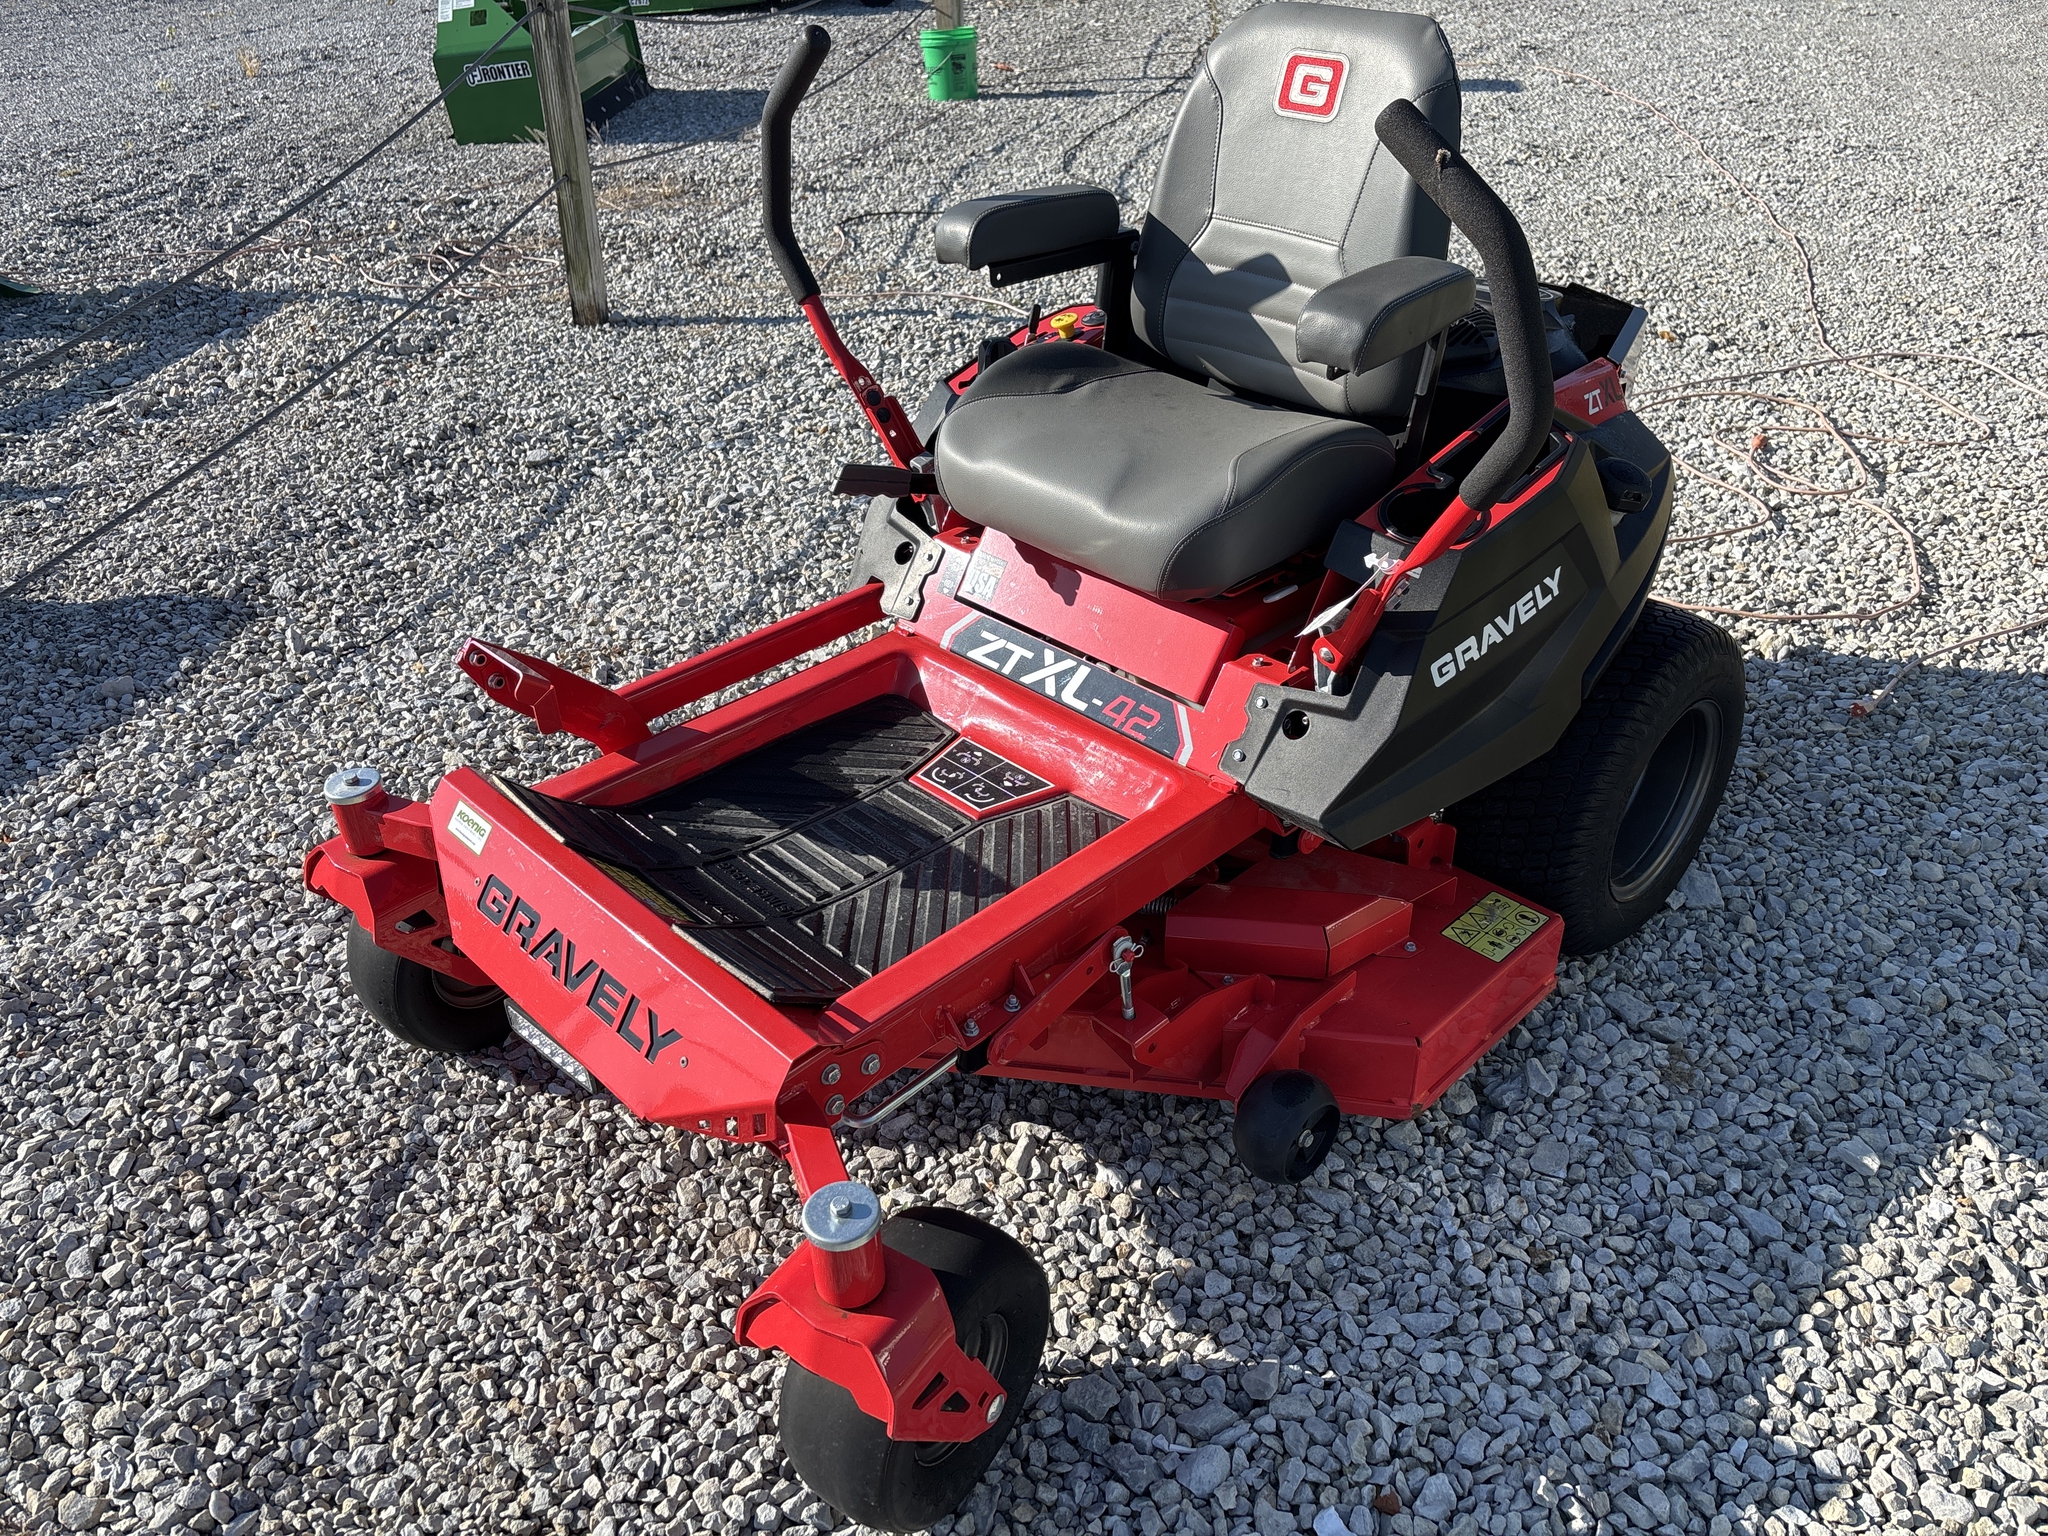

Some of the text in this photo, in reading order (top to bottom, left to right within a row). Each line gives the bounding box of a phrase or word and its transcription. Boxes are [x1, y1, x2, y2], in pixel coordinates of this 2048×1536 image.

[1288, 63, 1334, 107] G
[1430, 566, 1562, 688] GRAVELY
[477, 874, 683, 1064] GRAVELY
